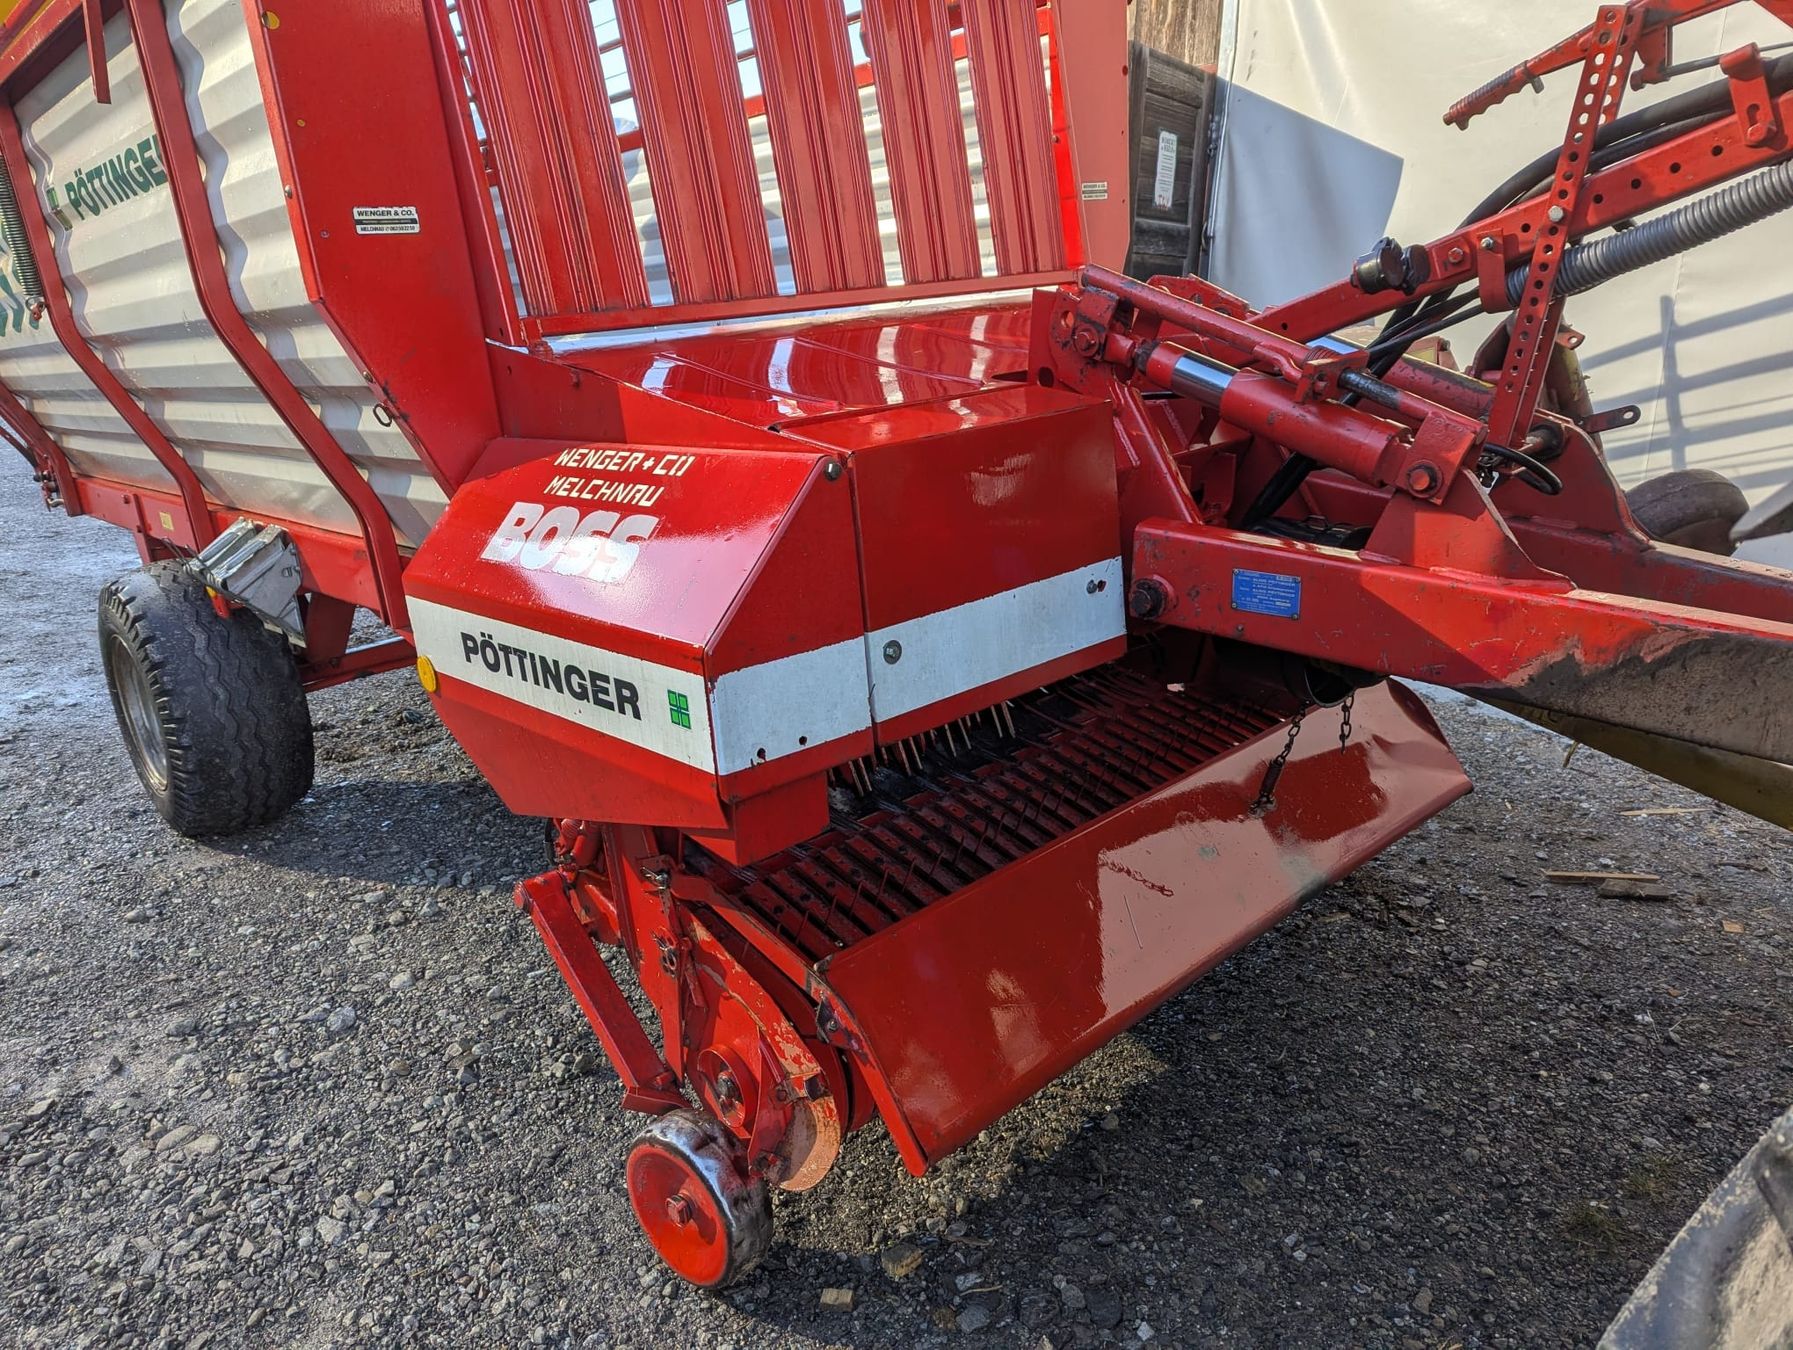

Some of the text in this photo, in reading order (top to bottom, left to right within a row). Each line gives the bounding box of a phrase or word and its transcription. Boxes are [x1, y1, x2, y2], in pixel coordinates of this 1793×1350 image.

[356, 209, 392, 217] WENGER
[553, 447, 646, 472] WENGER
[543, 475, 665, 507] MELCHNAU
[480, 501, 660, 584] BOSS
[460, 631, 642, 721] PÖTTINGER
